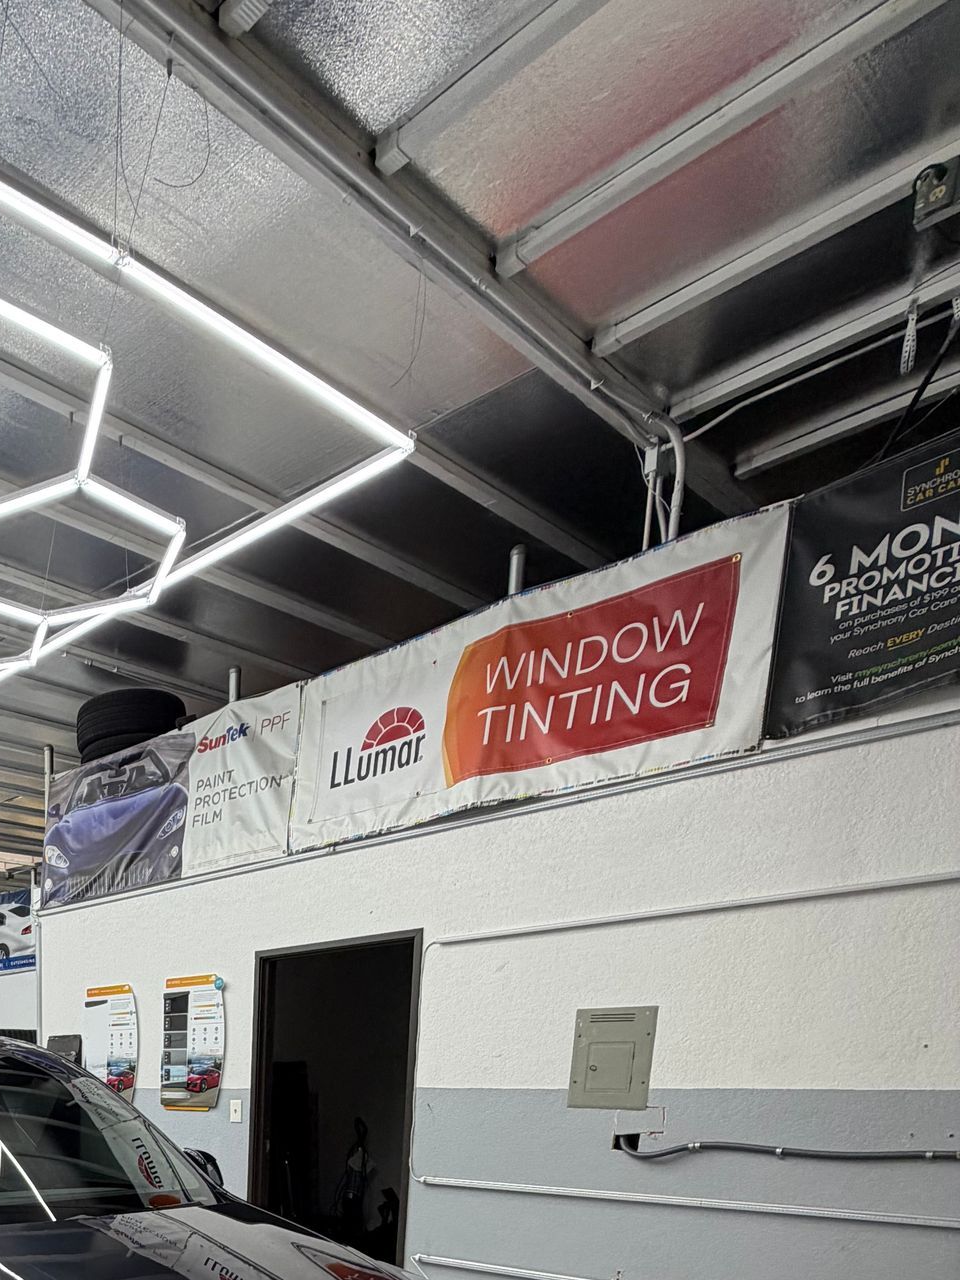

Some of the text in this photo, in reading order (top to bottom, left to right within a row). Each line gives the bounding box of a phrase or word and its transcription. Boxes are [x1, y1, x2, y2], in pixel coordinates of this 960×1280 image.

[907, 487, 933, 505] CAR
[808, 515, 960, 586] 6 MON
[830, 631, 852, 644] your
[853, 614, 906, 637] Synchrony
[909, 606, 928, 618] Car
[839, 618, 853, 630] on
[854, 604, 908, 627] purchases
[909, 599, 921, 608] of
[922, 587, 949, 603] $199
[486, 602, 705, 694] WINDOW
[848, 641, 884, 659] Reach
[887, 628, 925, 647] EVERY
[795, 695, 806, 704] to
[806, 687, 831, 700] learn
[834, 682, 851, 693] the
[853, 678, 870, 690] full
[871, 664, 913, 684] benefits
[914, 657, 926, 669] of
[831, 672, 853, 684] Visit
[477, 662, 692, 746] TINTING
[197, 710, 291, 753] SunTek PPF
[196, 769, 235, 793] PAINT
[329, 733, 426, 790] LLumar
[194, 775, 282, 810] PROTECTION
[192, 808, 223, 828] FILM
